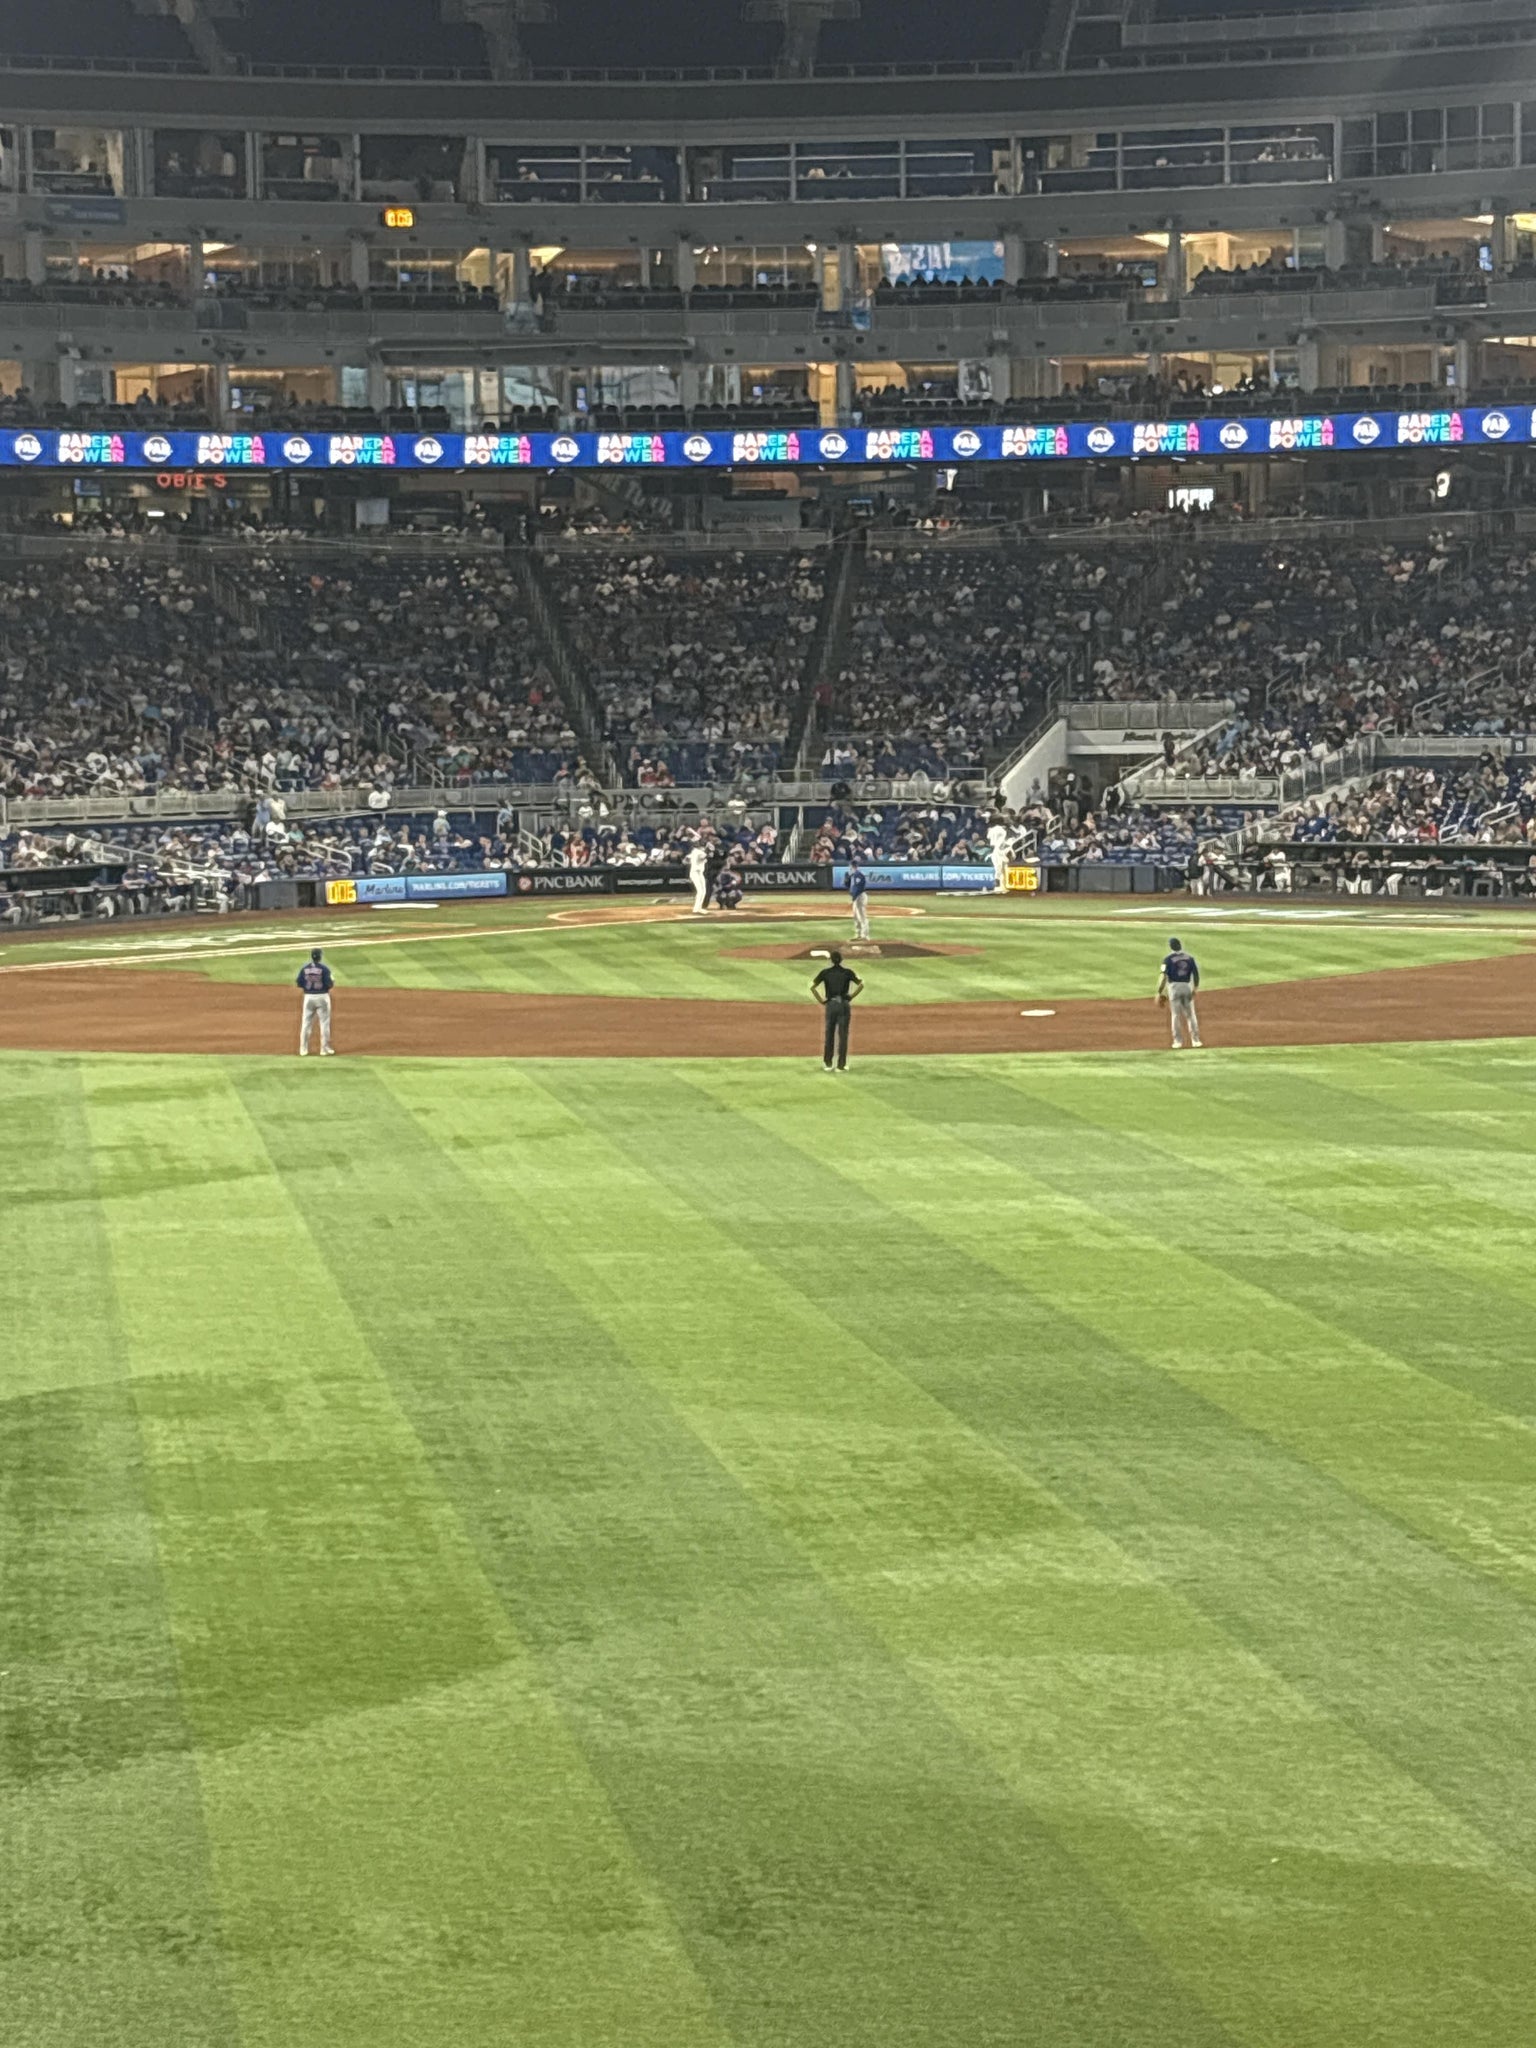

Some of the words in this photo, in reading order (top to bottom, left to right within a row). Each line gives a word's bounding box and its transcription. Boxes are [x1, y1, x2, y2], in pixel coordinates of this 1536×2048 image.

[1269, 432, 1333, 448] POWER
[1398, 426, 1463, 443] POWER
[866, 443, 933, 459] POWER
[1002, 440, 1067, 455] POWER
[1132, 436, 1199, 451] POWER
[58, 447, 124, 462] POWER
[198, 448, 264, 463] POWER
[329, 449, 395, 464] POWER
[464, 449, 530, 464] POWER
[597, 448, 664, 463] POWER
[733, 446, 799, 461] POWER
[534, 877, 565, 889] PNC
[565, 875, 604, 887] BANK
[744, 872, 776, 884] PNC
[776, 871, 817, 884] BANK
